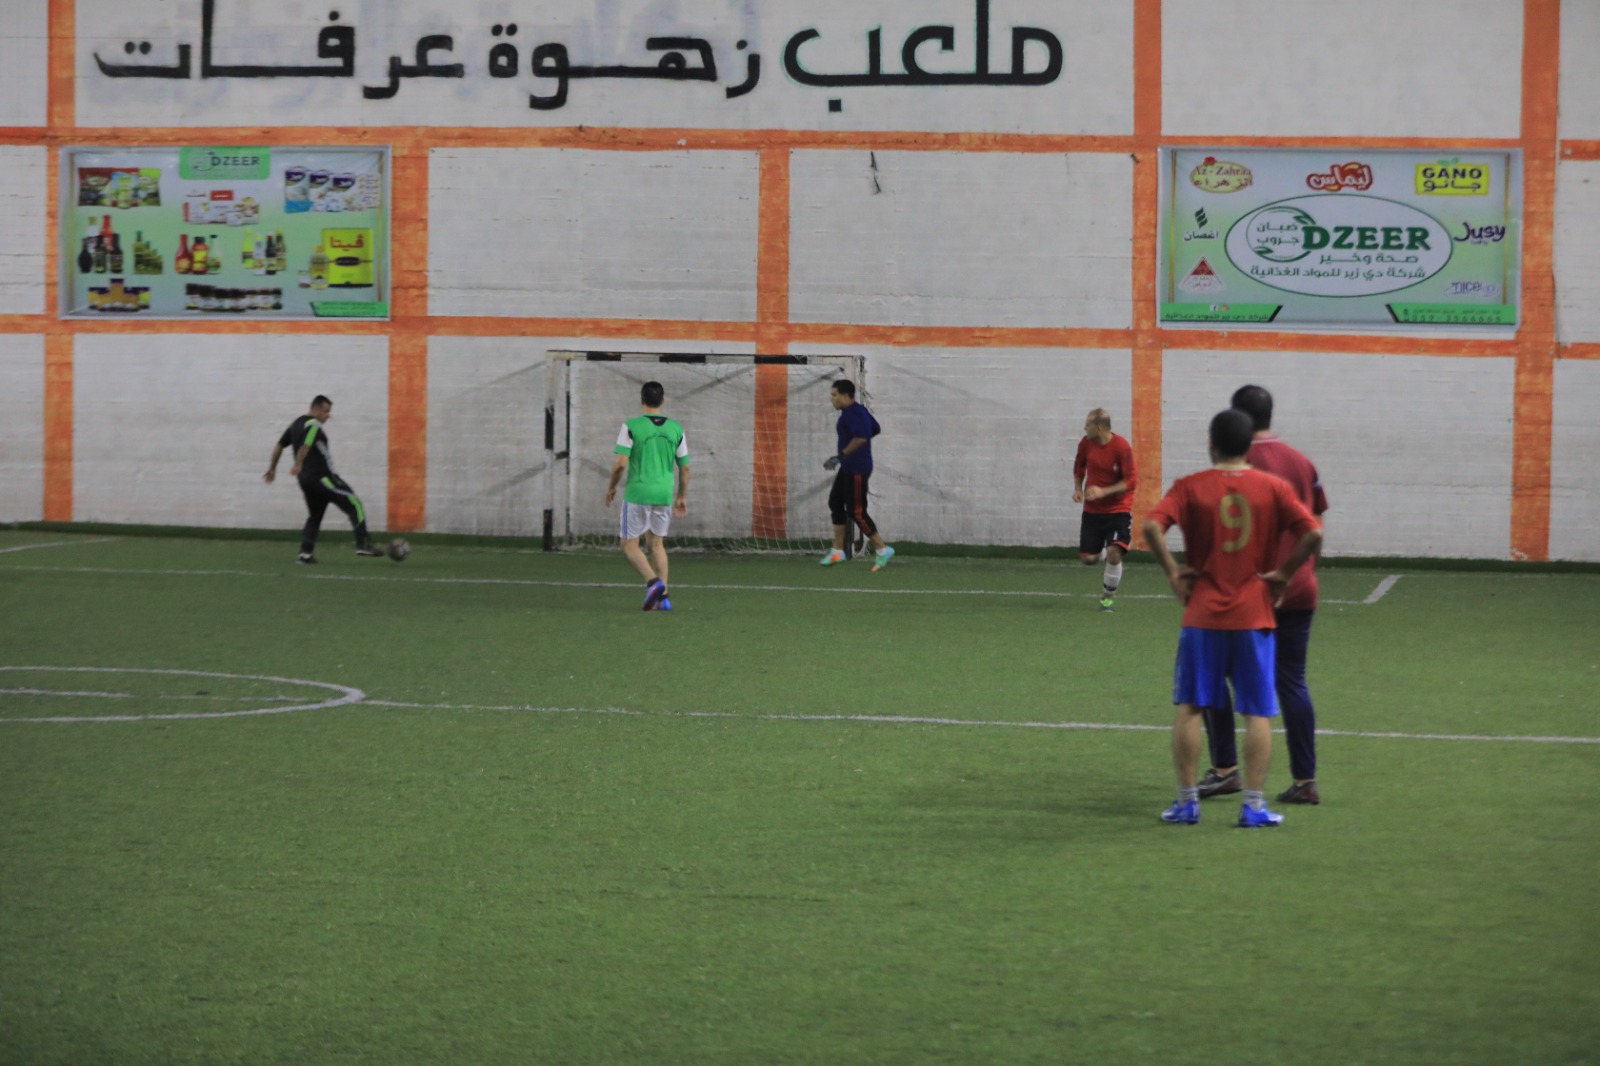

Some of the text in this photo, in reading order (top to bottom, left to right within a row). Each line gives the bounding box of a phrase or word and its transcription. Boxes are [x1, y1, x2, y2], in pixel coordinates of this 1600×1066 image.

[94, 0, 465, 99] عرفات
[781, 0, 1063, 113] ملعب
[211, 156, 260, 167] DZEER
[1422, 168, 1482, 179] GANO
[1423, 180, 1482, 193] جانو
[1453, 221, 1506, 242] Jusy
[1301, 226, 1431, 251] DZEER
[1319, 253, 1419, 265] صحة وخير
[1302, 268, 1341, 278] للمواد
[1362, 269, 1383, 281] دي
[1386, 267, 1426, 279] شركة
[1219, 492, 1252, 554] 9
